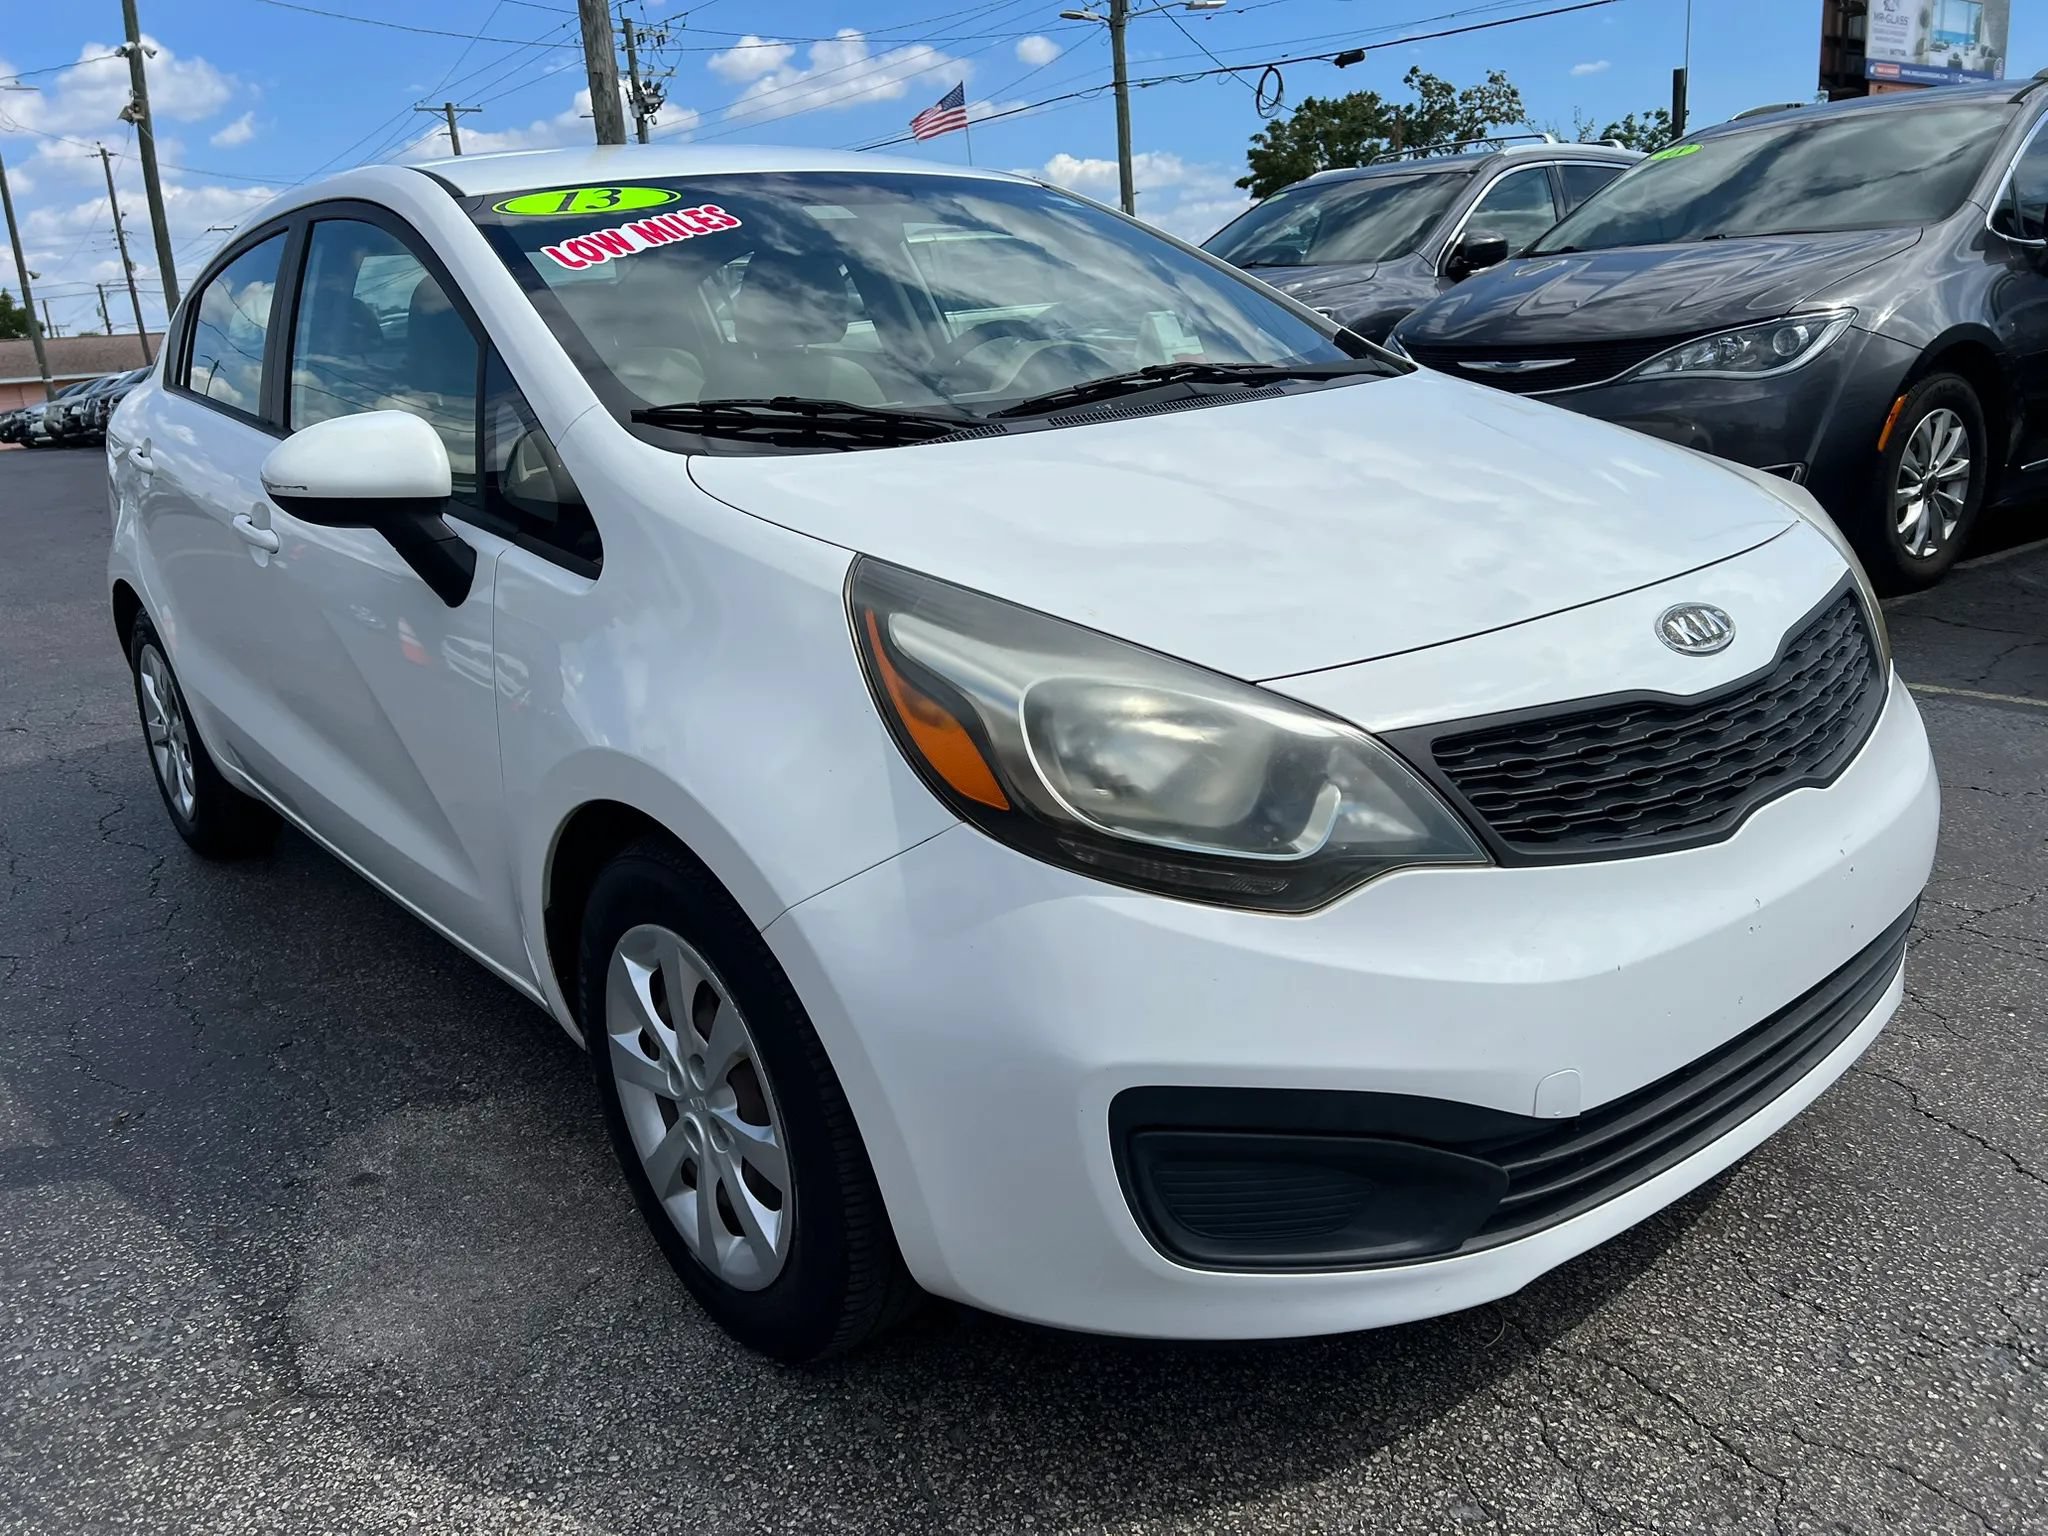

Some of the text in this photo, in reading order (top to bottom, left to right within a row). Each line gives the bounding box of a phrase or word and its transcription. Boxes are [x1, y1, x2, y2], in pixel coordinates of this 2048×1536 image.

[547, 188, 622, 213] 13
[546, 205, 739, 268] LOW MILES
[1666, 608, 1730, 646] KIA
